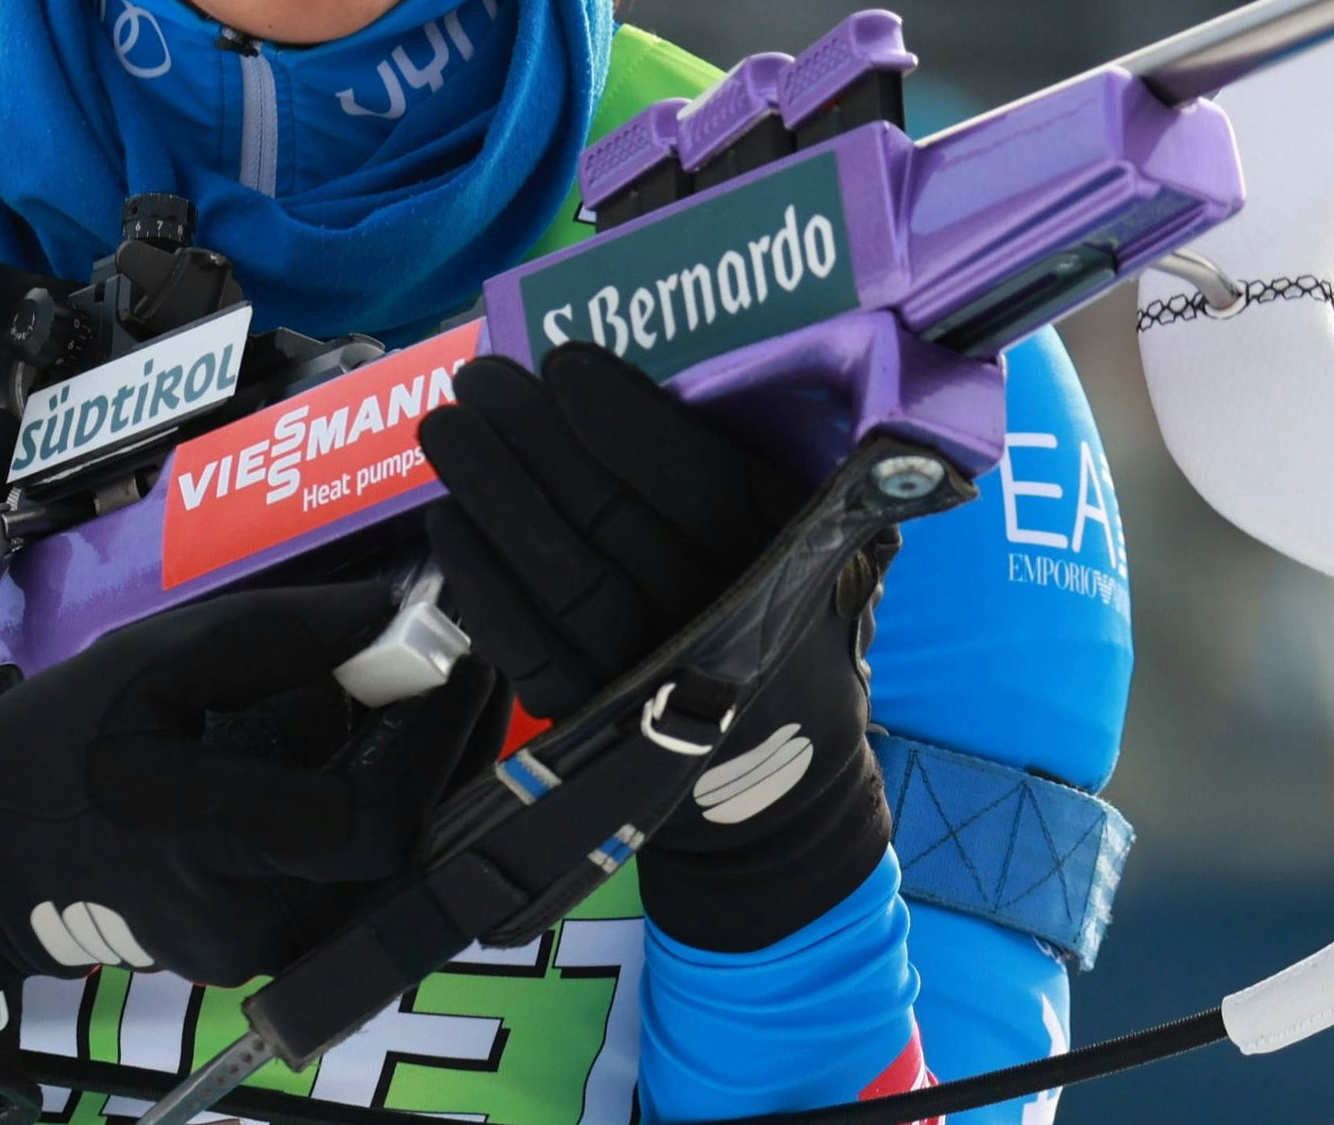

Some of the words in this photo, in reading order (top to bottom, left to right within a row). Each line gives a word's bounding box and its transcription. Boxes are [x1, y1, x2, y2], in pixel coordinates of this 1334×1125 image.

[587, 203, 836, 358] Bernardo
[178, 358, 465, 511] VIESSMANN
[303, 473, 350, 512] Heat
[356, 446, 425, 496] pumps
[1008, 553, 1099, 598] EMPORIO
